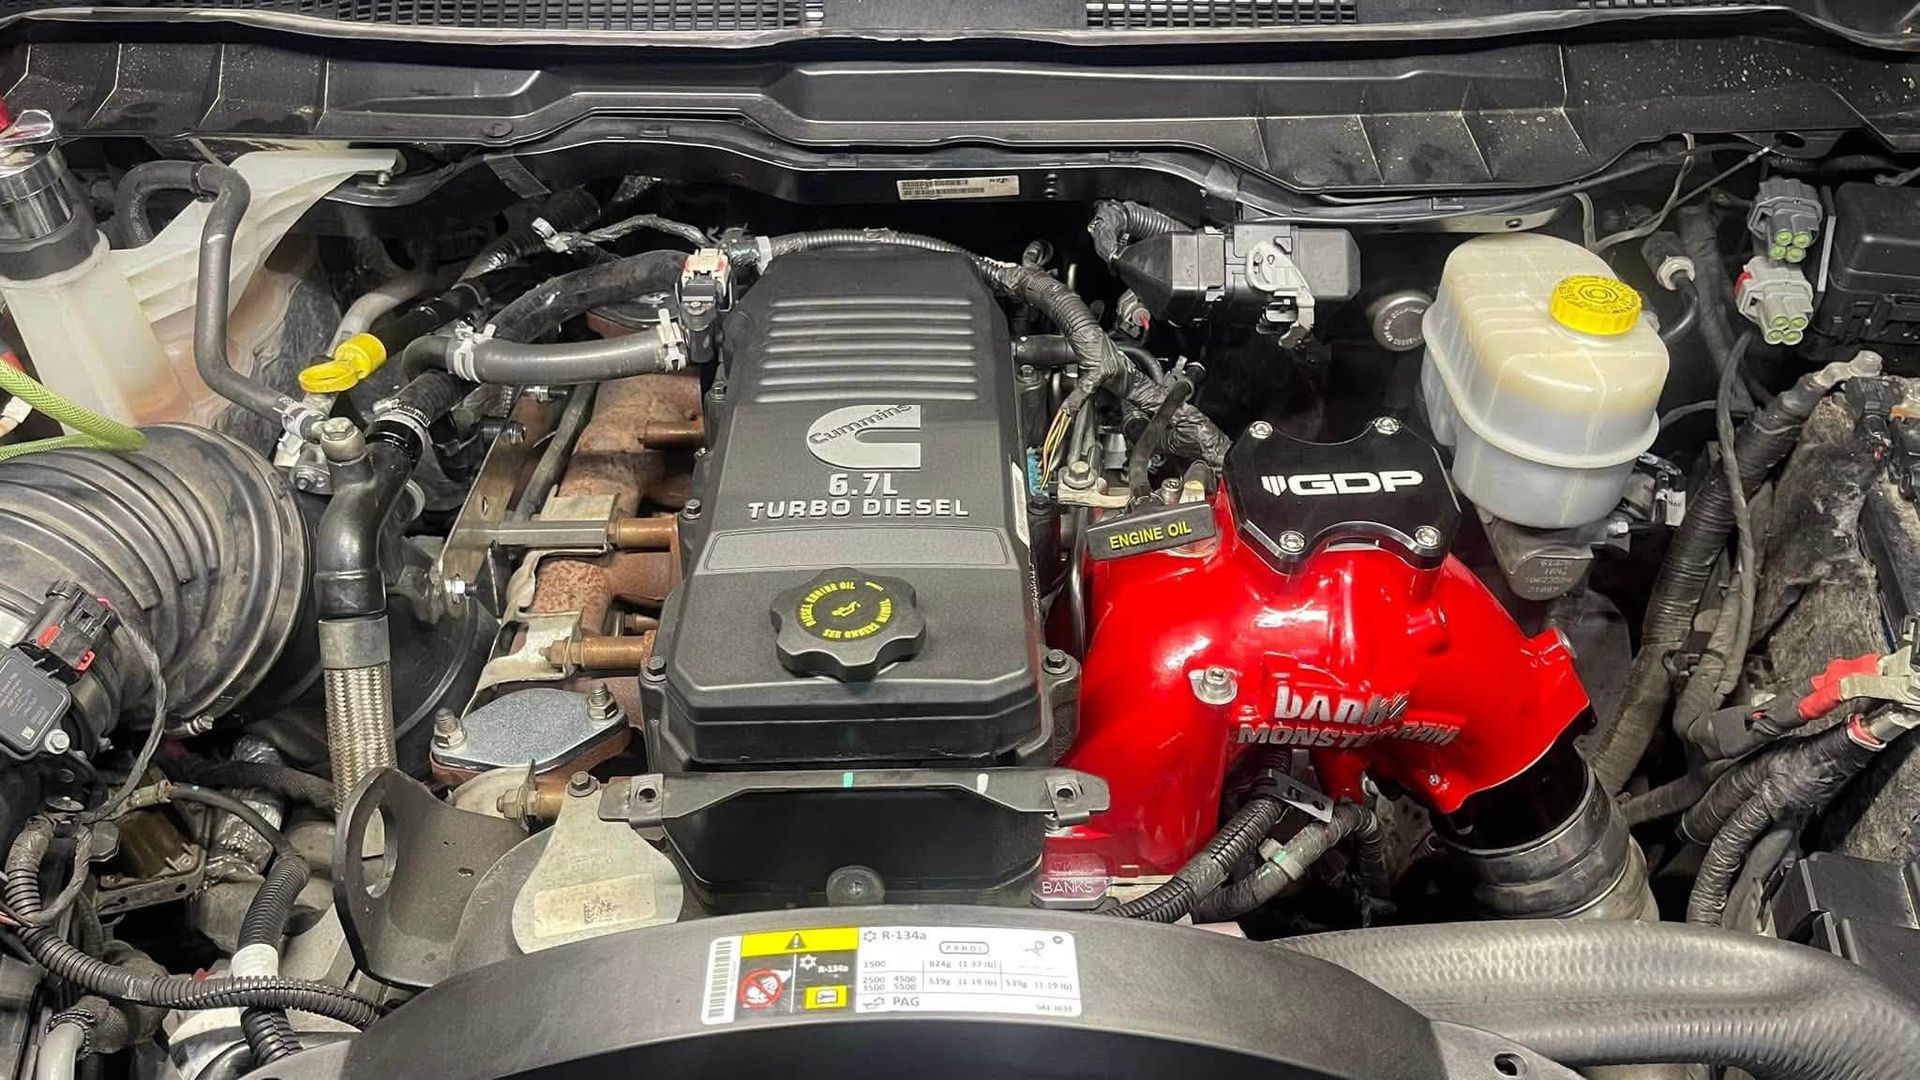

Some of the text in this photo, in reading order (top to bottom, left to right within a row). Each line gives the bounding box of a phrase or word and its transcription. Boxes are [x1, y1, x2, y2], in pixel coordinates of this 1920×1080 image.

[808, 403, 913, 445] Cummins
[828, 473, 898, 497] 6.7L
[1287, 469, 1424, 497] GDP
[748, 498, 970, 520] TURBO DIESEL
[1109, 520, 1193, 549] ENGINE OIL
[839, 581, 856, 590] OIL
[1042, 881, 1094, 894] BANKS
[882, 930, 927, 941] R-134a
[863, 960, 886, 969] 1500
[892, 996, 920, 1007] PAG
